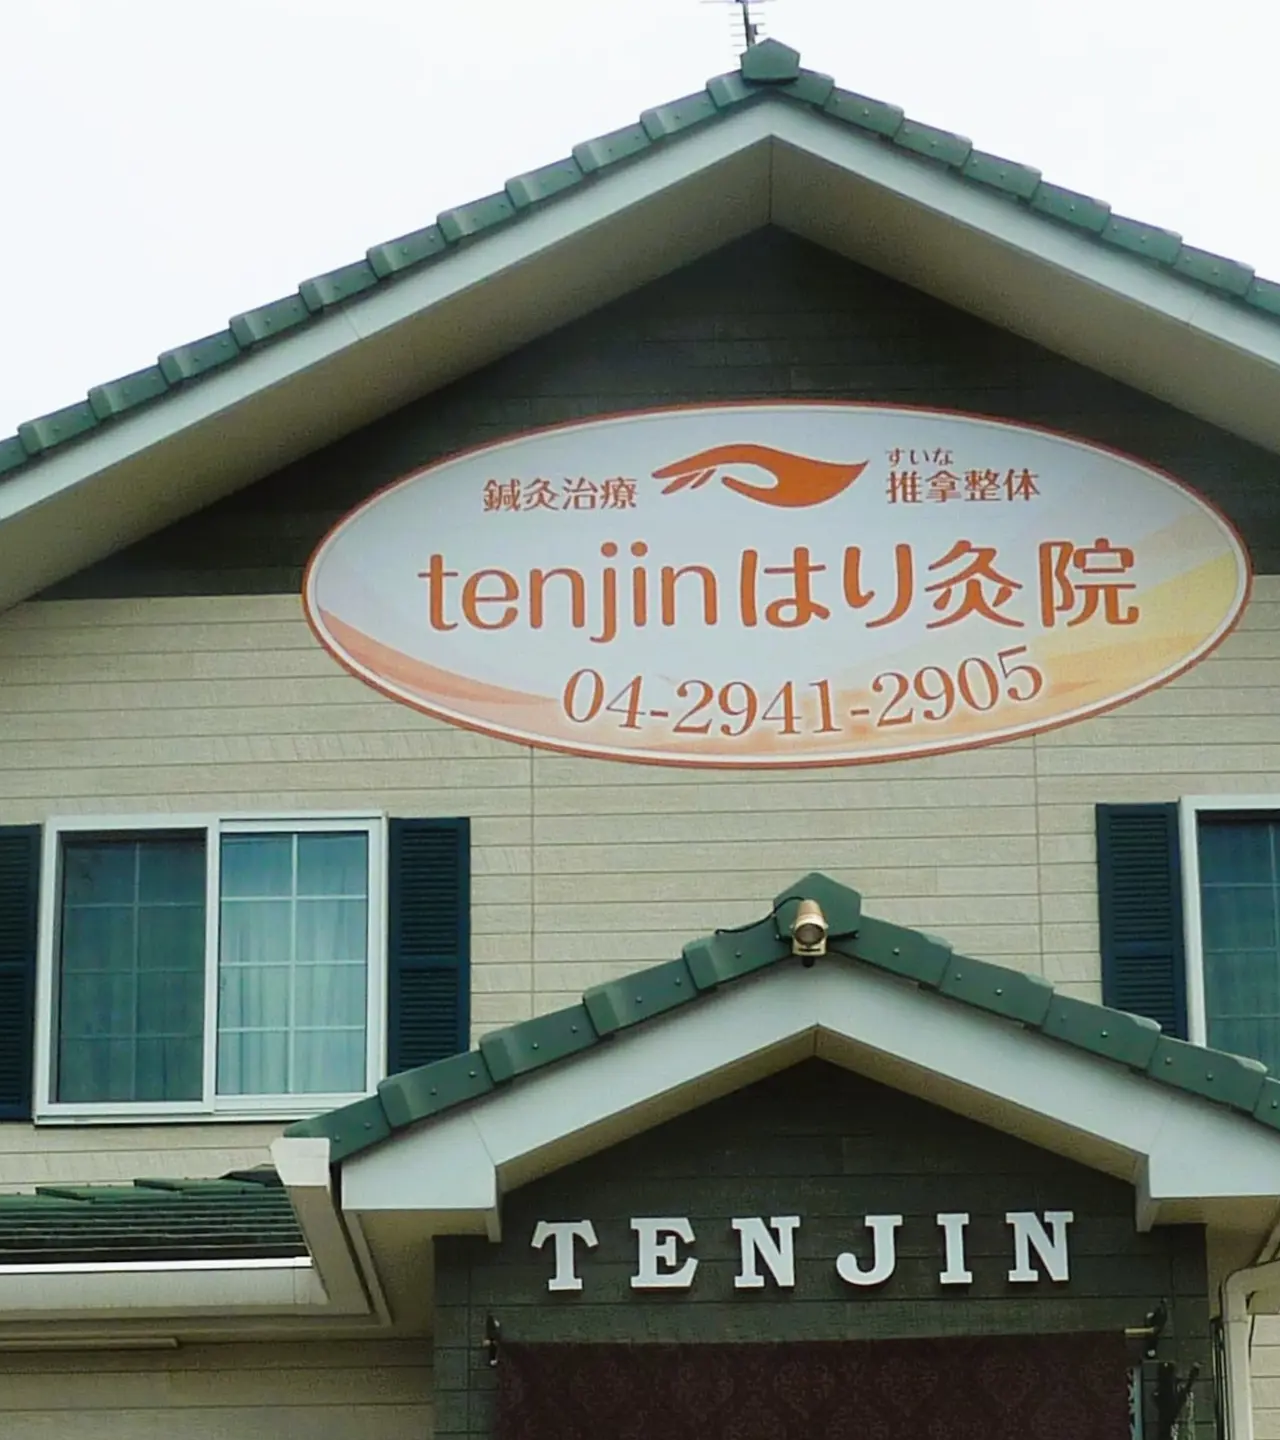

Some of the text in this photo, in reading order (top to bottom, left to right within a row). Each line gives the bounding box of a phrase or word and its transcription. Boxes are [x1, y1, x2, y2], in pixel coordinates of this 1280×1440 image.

[482, 467, 1041, 513] 鍼灸治療 推拿整体
[886, 447, 954, 467] すいな
[418, 538, 1140, 643] tenjinはり灸院
[561, 645, 1045, 738] 04-2941-2905
[531, 1210, 1074, 1291] TENJIN
